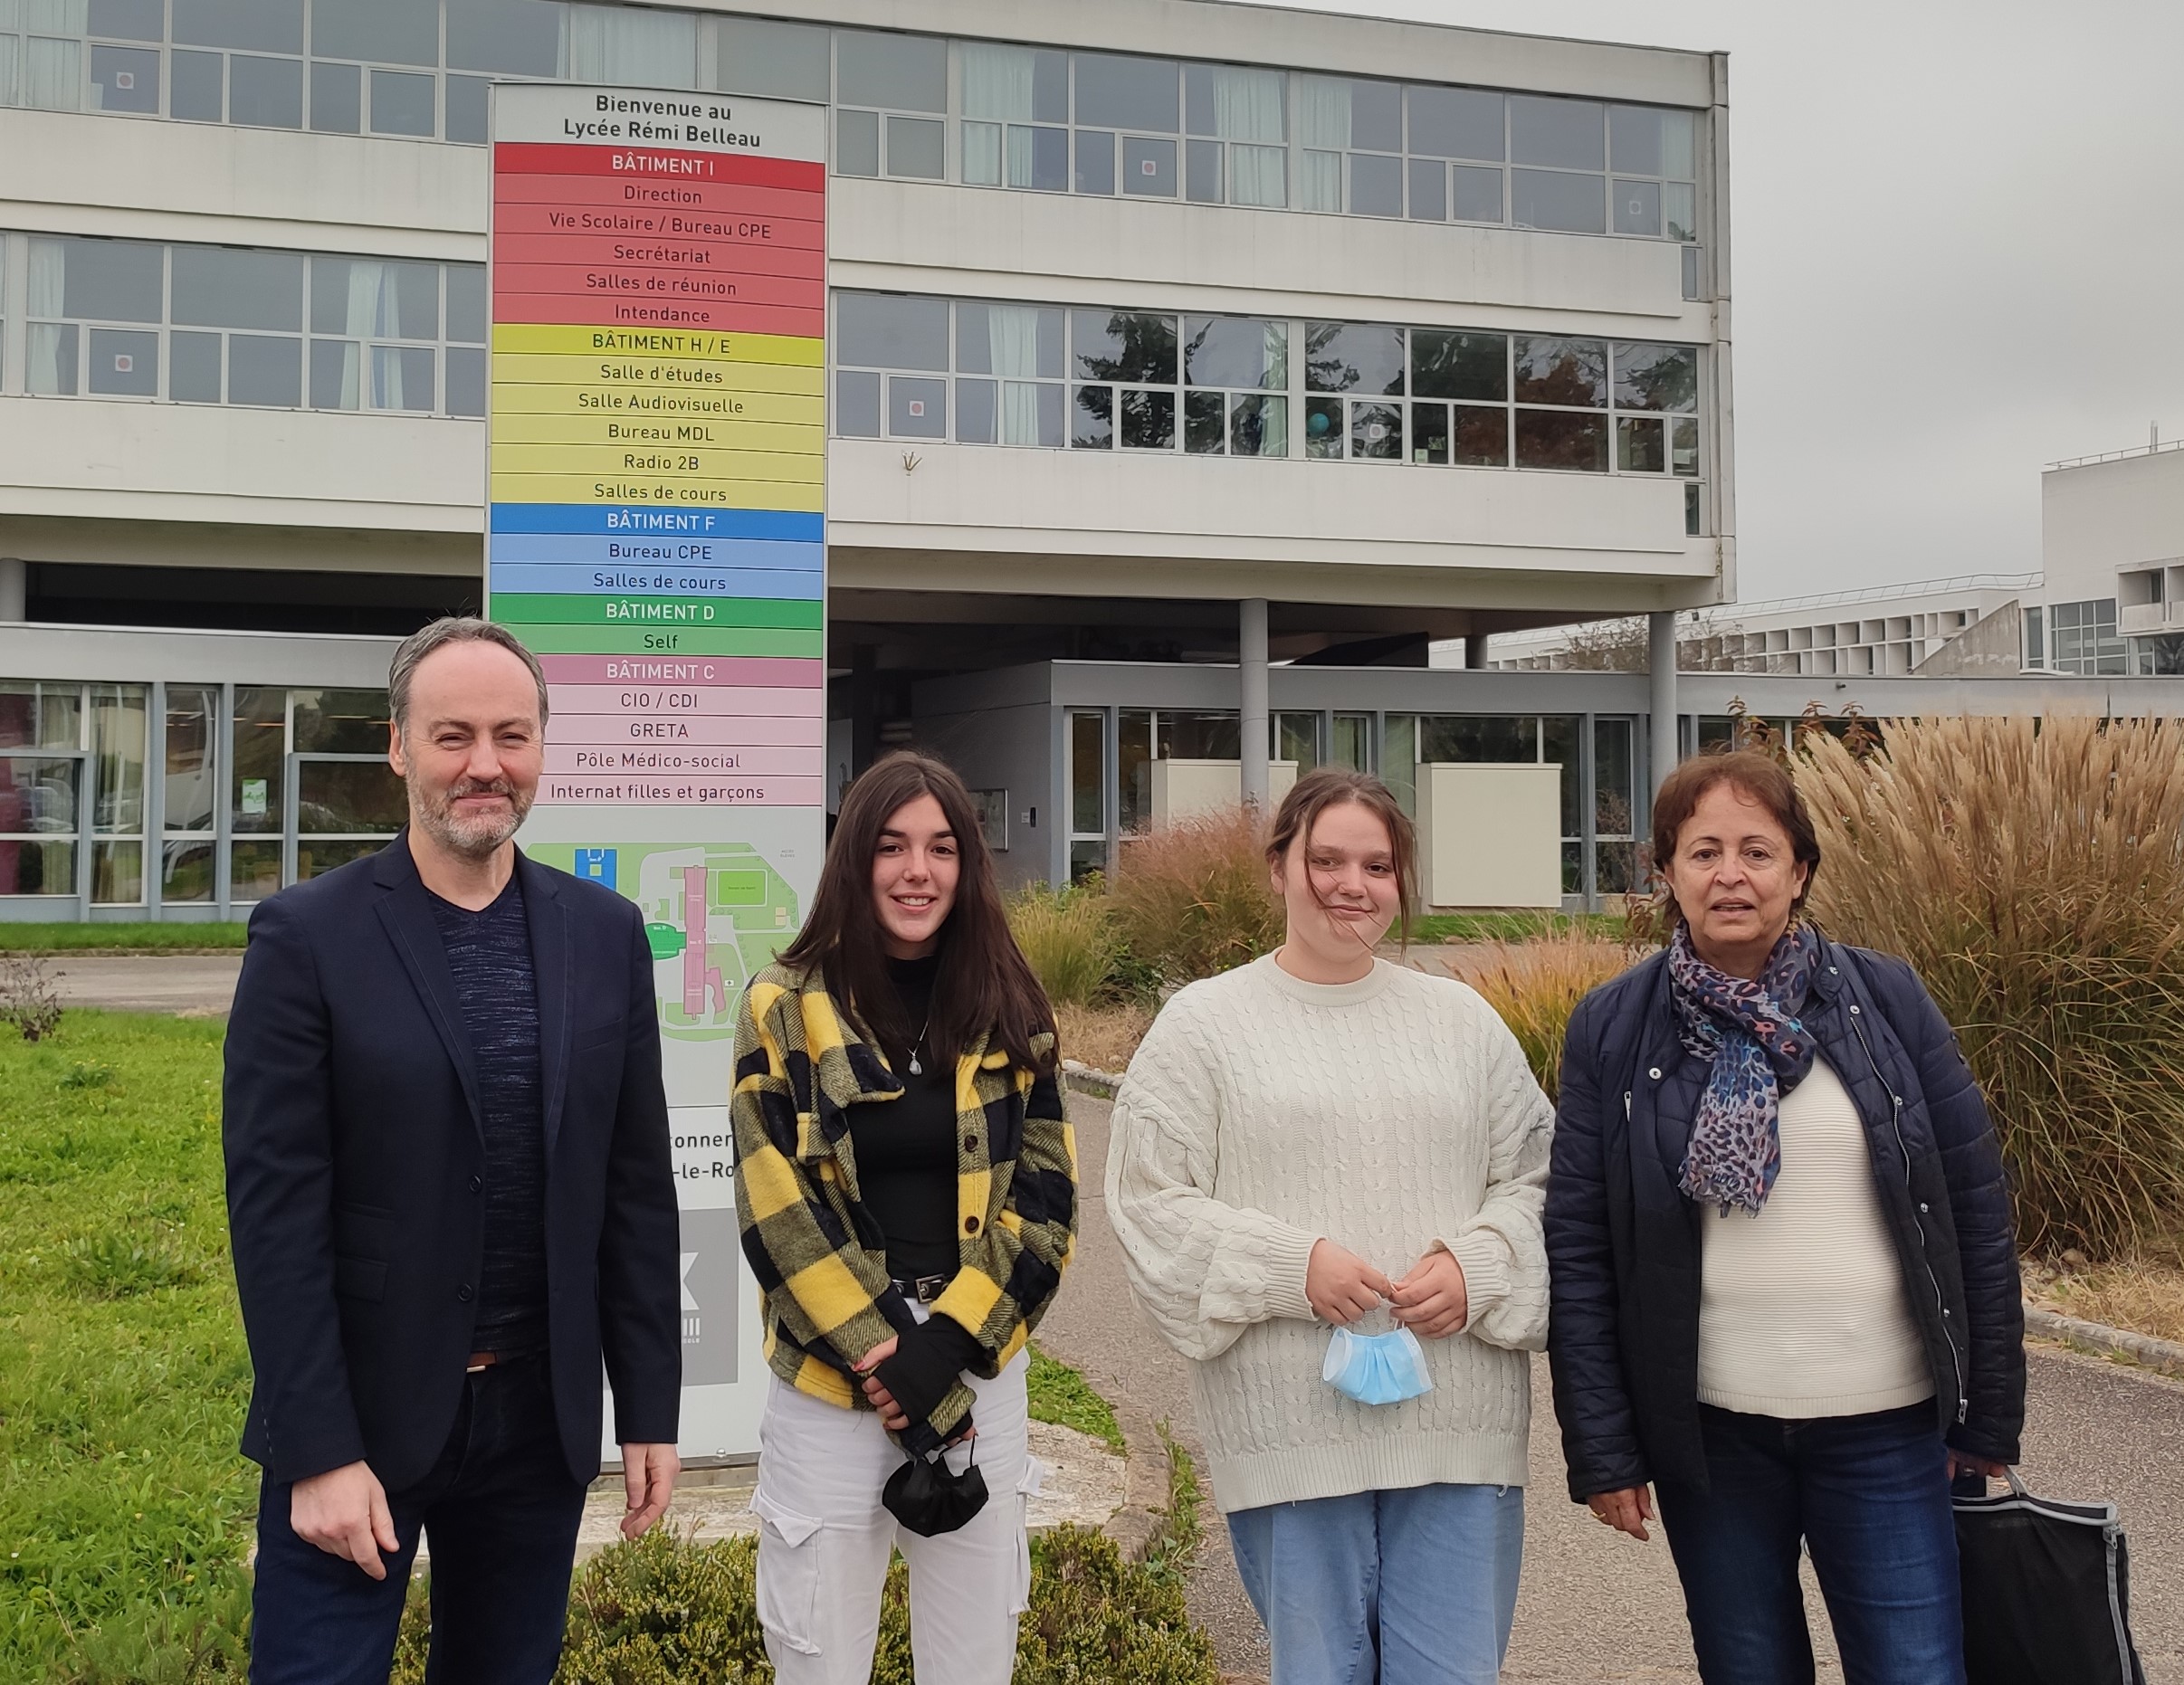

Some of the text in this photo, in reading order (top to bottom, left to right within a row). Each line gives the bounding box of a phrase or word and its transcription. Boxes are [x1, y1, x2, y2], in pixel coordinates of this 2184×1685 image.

[596, 95, 730, 120] Bienvenue au
[565, 119, 759, 147] Lycée Rémi Belleau
[613, 152, 712, 176] BÂTIMENT I
[625, 186, 701, 204] Direction
[549, 213, 770, 239] Vie Scolaire / Bureau CPE
[615, 245, 710, 263] Secrétariat
[587, 273, 736, 295] Salles de réunion
[616, 304, 710, 322] Intendance
[594, 330, 730, 354] BÂTIMENT H / E
[601, 365, 722, 383] Salle d'études
[579, 394, 742, 413] Salle Audiovisuelle
[609, 424, 714, 441] Bureau MDL
[625, 454, 698, 470] Radio 2B
[595, 484, 726, 500] Salles de cours
[608, 509, 715, 530] BÂTIMENT F
[610, 544, 711, 559] Bureau CPE
[594, 573, 725, 589] Salles de cours
[607, 600, 715, 619] BÂTIMENT D
[644, 634, 678, 648] Self
[607, 660, 714, 680] BÂTIMENT C
[622, 692, 697, 709] CIO / CDI
[631, 723, 688, 738] GRETA
[577, 753, 739, 767] Pôle Médico-social
[552, 785, 763, 802] Internat filles et garçons
[670, 1135, 732, 1148] onner
[672, 1161, 734, 1179] -le-Ro
